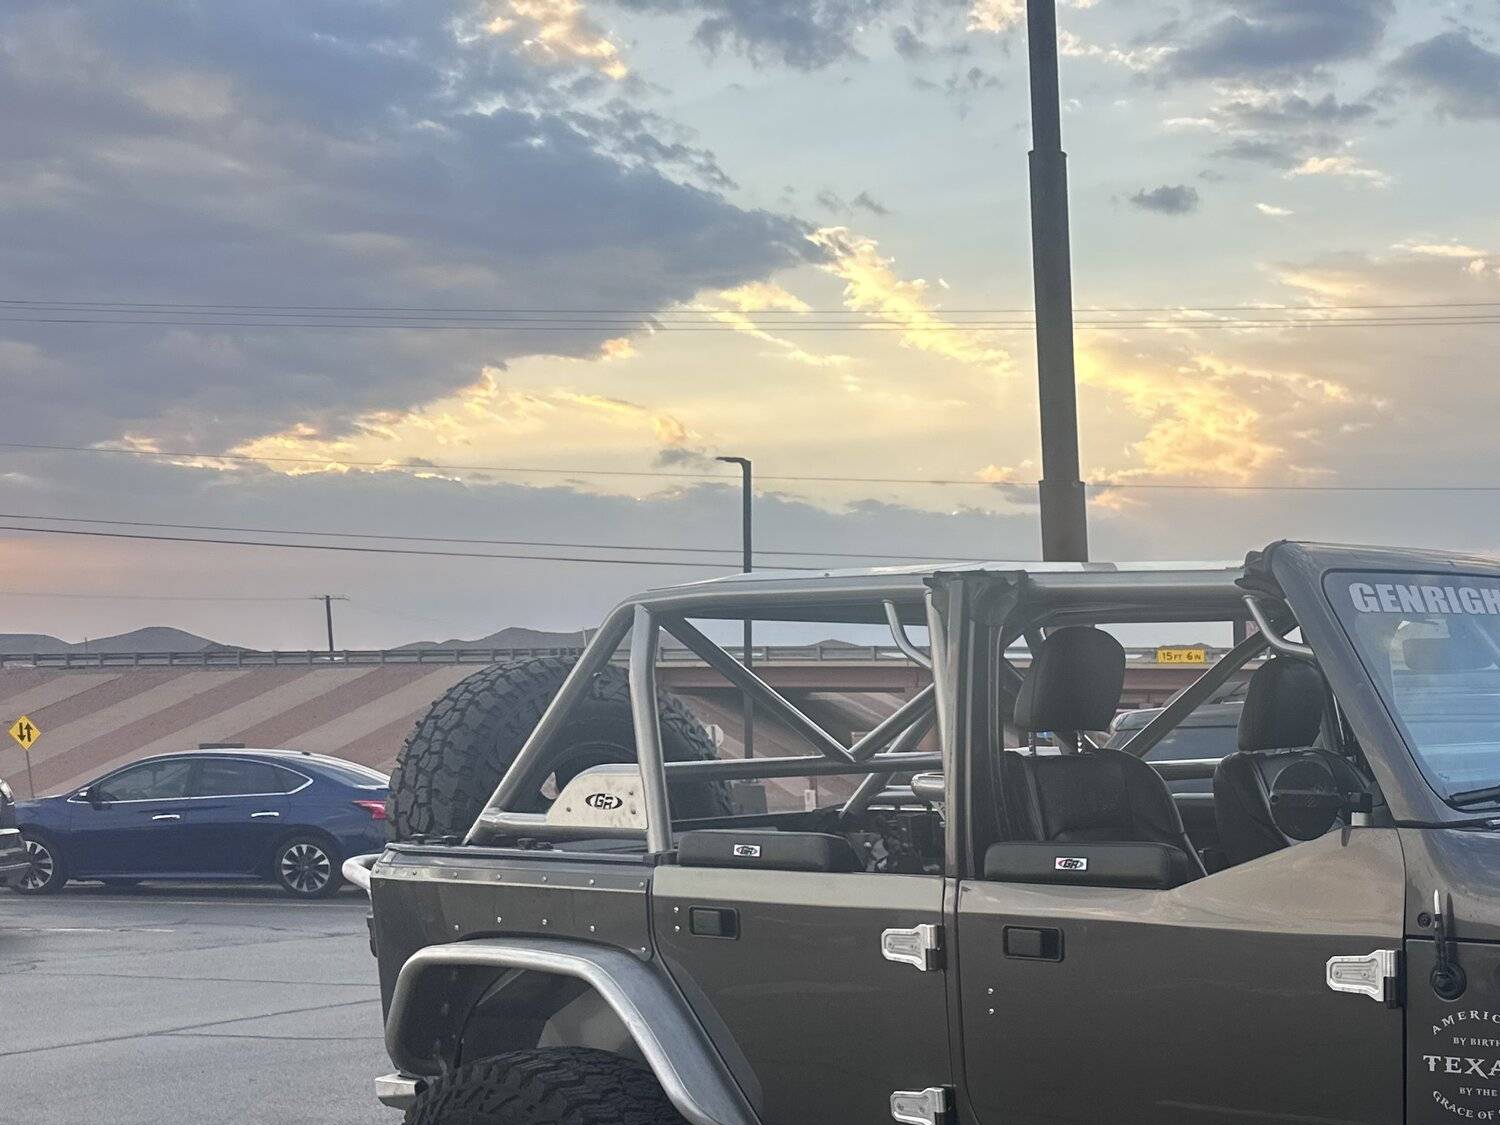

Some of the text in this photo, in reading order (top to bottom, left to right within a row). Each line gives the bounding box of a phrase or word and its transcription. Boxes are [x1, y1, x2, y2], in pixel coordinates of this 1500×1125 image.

[1452, 1036, 1467, 1046] BY
[1459, 1086, 1498, 1097] BY THE
[1432, 1089, 1474, 1119] GRACE
[1477, 1110, 1495, 1121] OF
